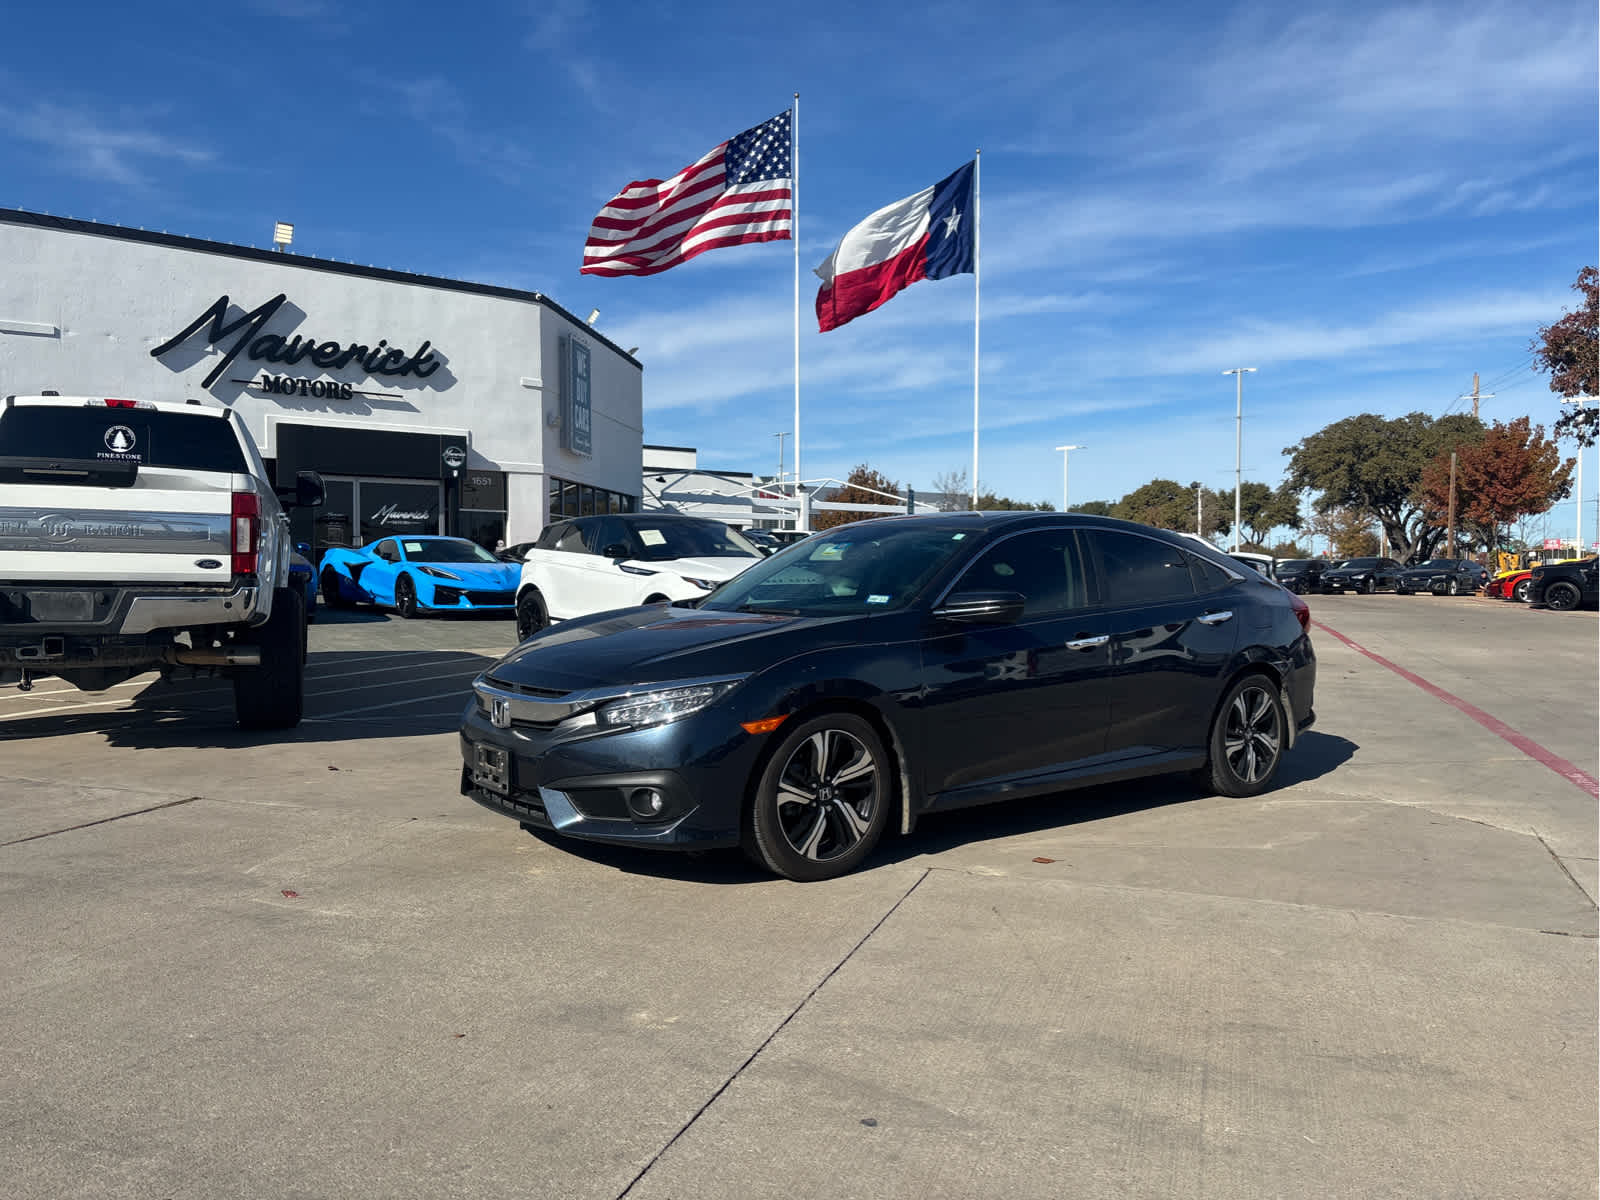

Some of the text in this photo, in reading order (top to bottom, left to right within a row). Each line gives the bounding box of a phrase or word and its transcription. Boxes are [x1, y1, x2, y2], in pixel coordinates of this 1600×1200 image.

[150, 293, 441, 389] Maverick
[261, 374, 353, 400] MOTORS
[96, 452, 142, 460] PINESTONE
[472, 477, 491, 486] 1651
[371, 503, 430, 526] Maverick
